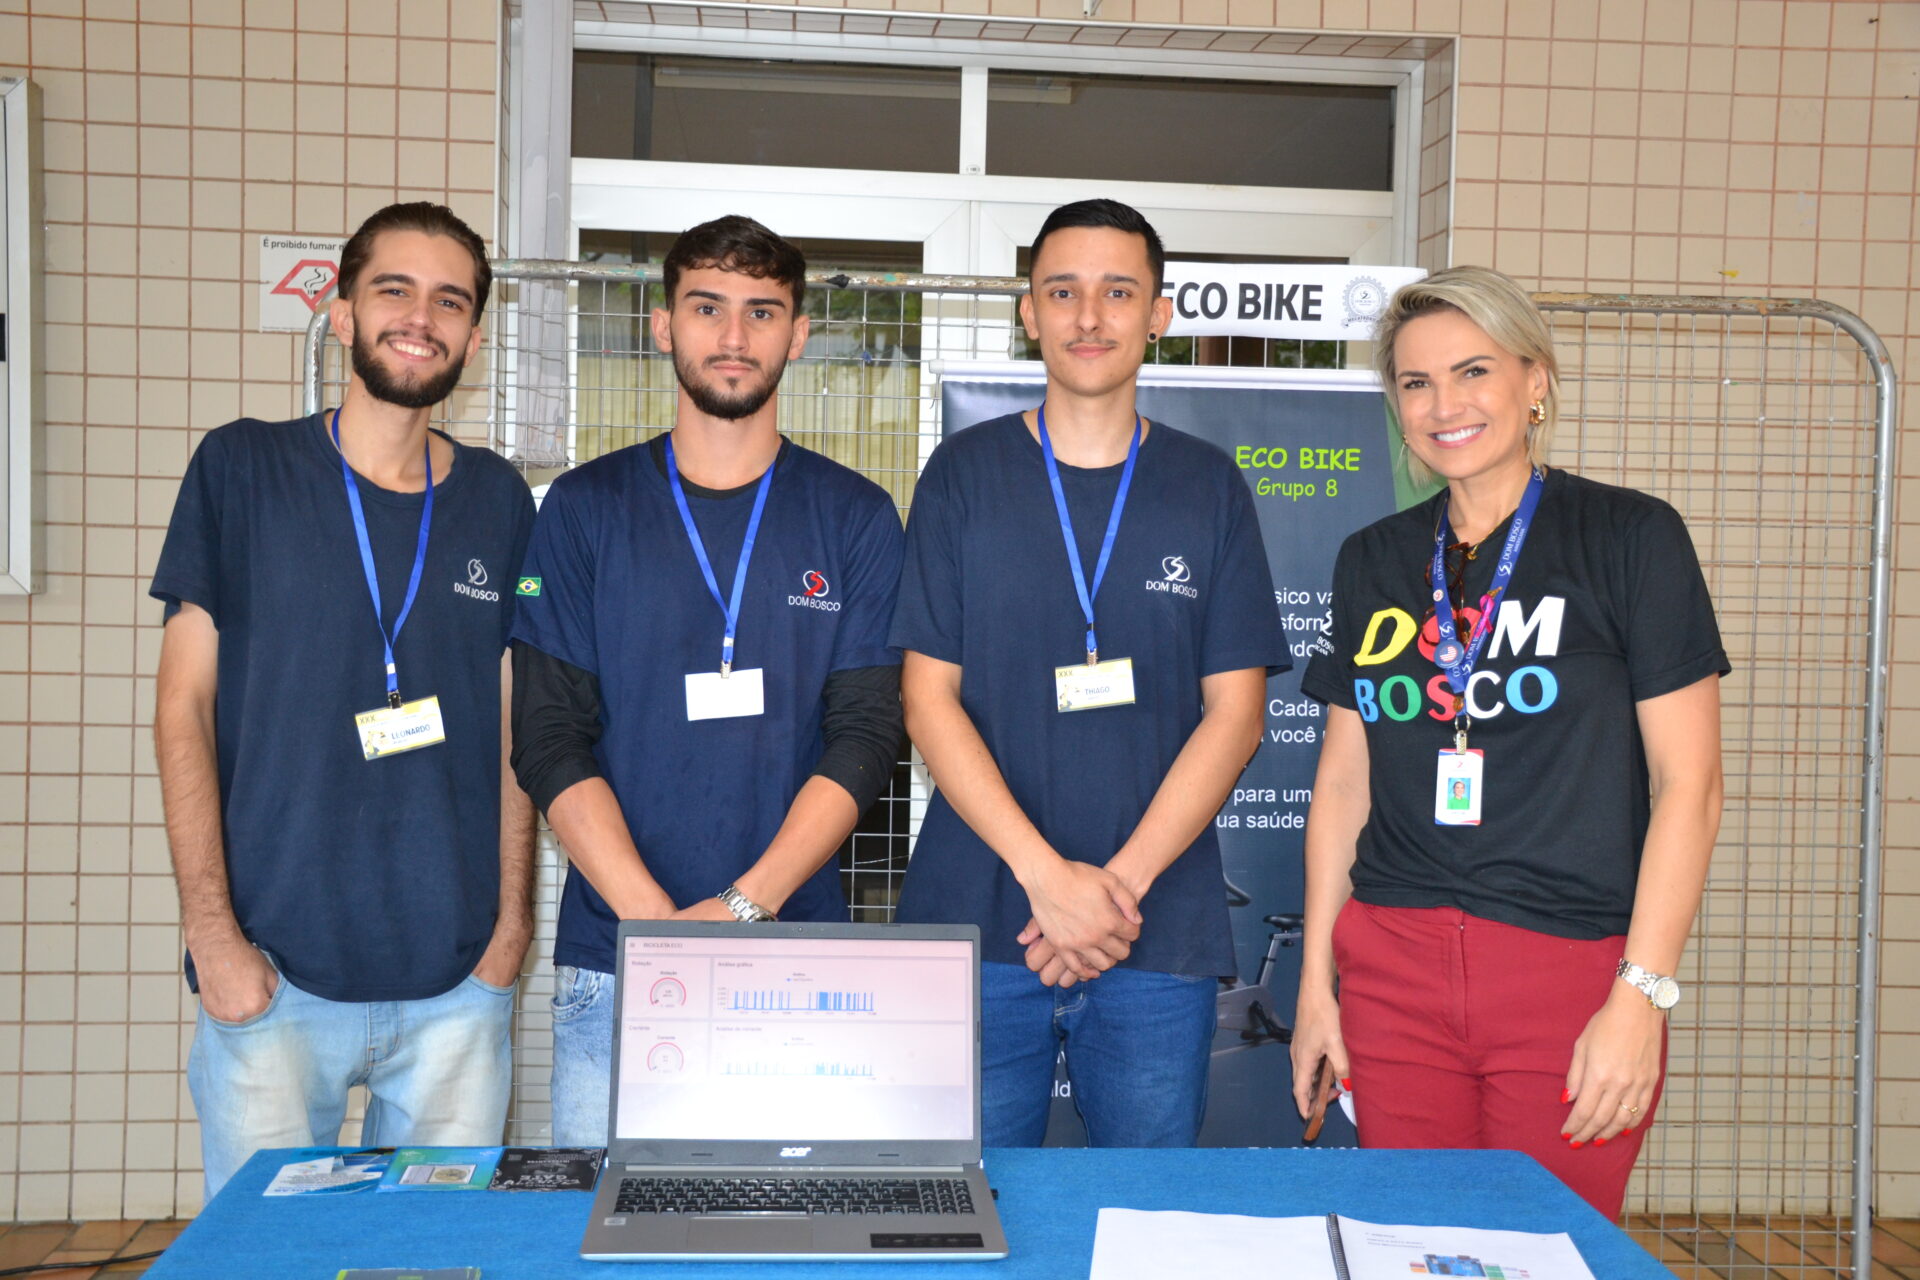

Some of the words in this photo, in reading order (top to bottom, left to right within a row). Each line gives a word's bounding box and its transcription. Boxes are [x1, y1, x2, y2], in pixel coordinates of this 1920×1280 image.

[263, 236, 269, 247] É
[271, 239, 308, 250] proibido
[309, 241, 336, 251] fumar
[1237, 283, 1323, 321] BIKE
[1235, 445, 1288, 469] ECO
[1299, 447, 1361, 471] BIKE
[1256, 477, 1316, 502] Grupo
[1325, 478, 1338, 497] 8
[1502, 542, 1514, 561] DOM
[1509, 518, 1523, 543] BOSCO
[454, 582, 470, 596] DOM
[470, 587, 499, 602] BOSCO
[1145, 580, 1169, 592] DOM
[1171, 583, 1198, 599] BOSCO
[788, 595, 810, 607] DOM
[809, 598, 841, 612] BOSCO
[1084, 686, 1110, 695] THIAGO
[1354, 666, 1559, 722] BOSCO
[1269, 699, 1320, 717] Cada
[391, 724, 431, 740] LEONARDO
[1270, 726, 1316, 743] você
[1233, 789, 1276, 806] para
[1246, 811, 1305, 828] saúde
[780, 1147, 811, 1157] acer
